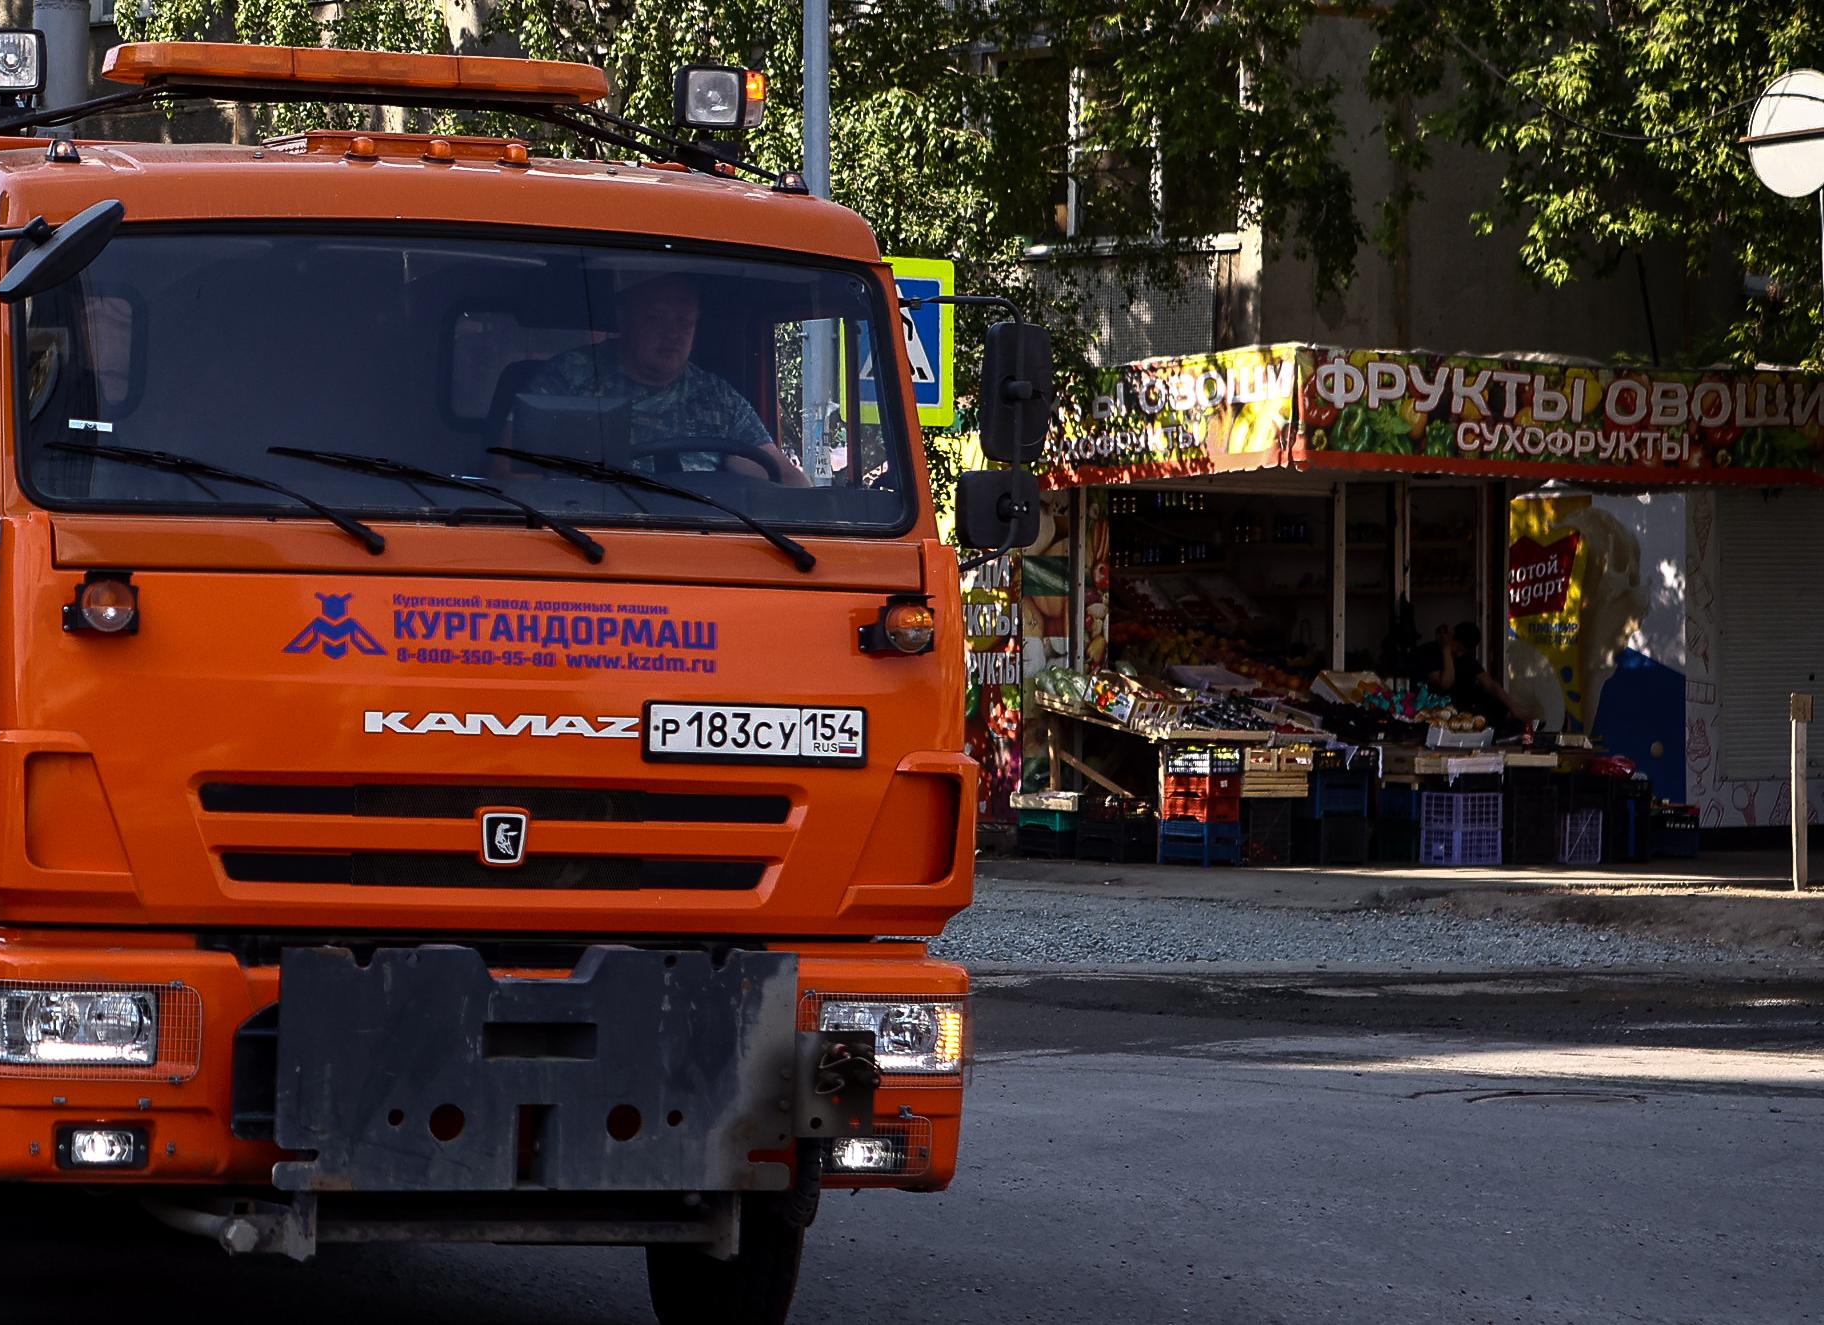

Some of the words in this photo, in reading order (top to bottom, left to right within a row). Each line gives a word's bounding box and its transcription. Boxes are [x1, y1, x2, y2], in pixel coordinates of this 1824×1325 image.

[1137, 361, 1296, 415] ОВОЩИ
[1315, 357, 1586, 424] ФРУКТЫ
[1604, 378, 1824, 429] ОВОЩИ
[1456, 421, 1691, 461] СУХОФРУКТЫ
[1508, 554, 1558, 584] лотой
[392, 593, 481, 608] Курганский
[485, 598, 530, 611] завод
[533, 600, 613, 614] дорожных
[616, 603, 669, 615] машин
[1509, 576, 1566, 607] ндарт
[393, 610, 718, 650] КУРГАНДОРМАШ
[966, 603, 1018, 636] КТЫ
[565, 652, 717, 674] www.kzdm.ru
[967, 652, 1021, 685] РУКТЫ
[363, 711, 640, 738] KAMAZ
[803, 712, 853, 742] 154
[813, 742, 838, 753] RUS
